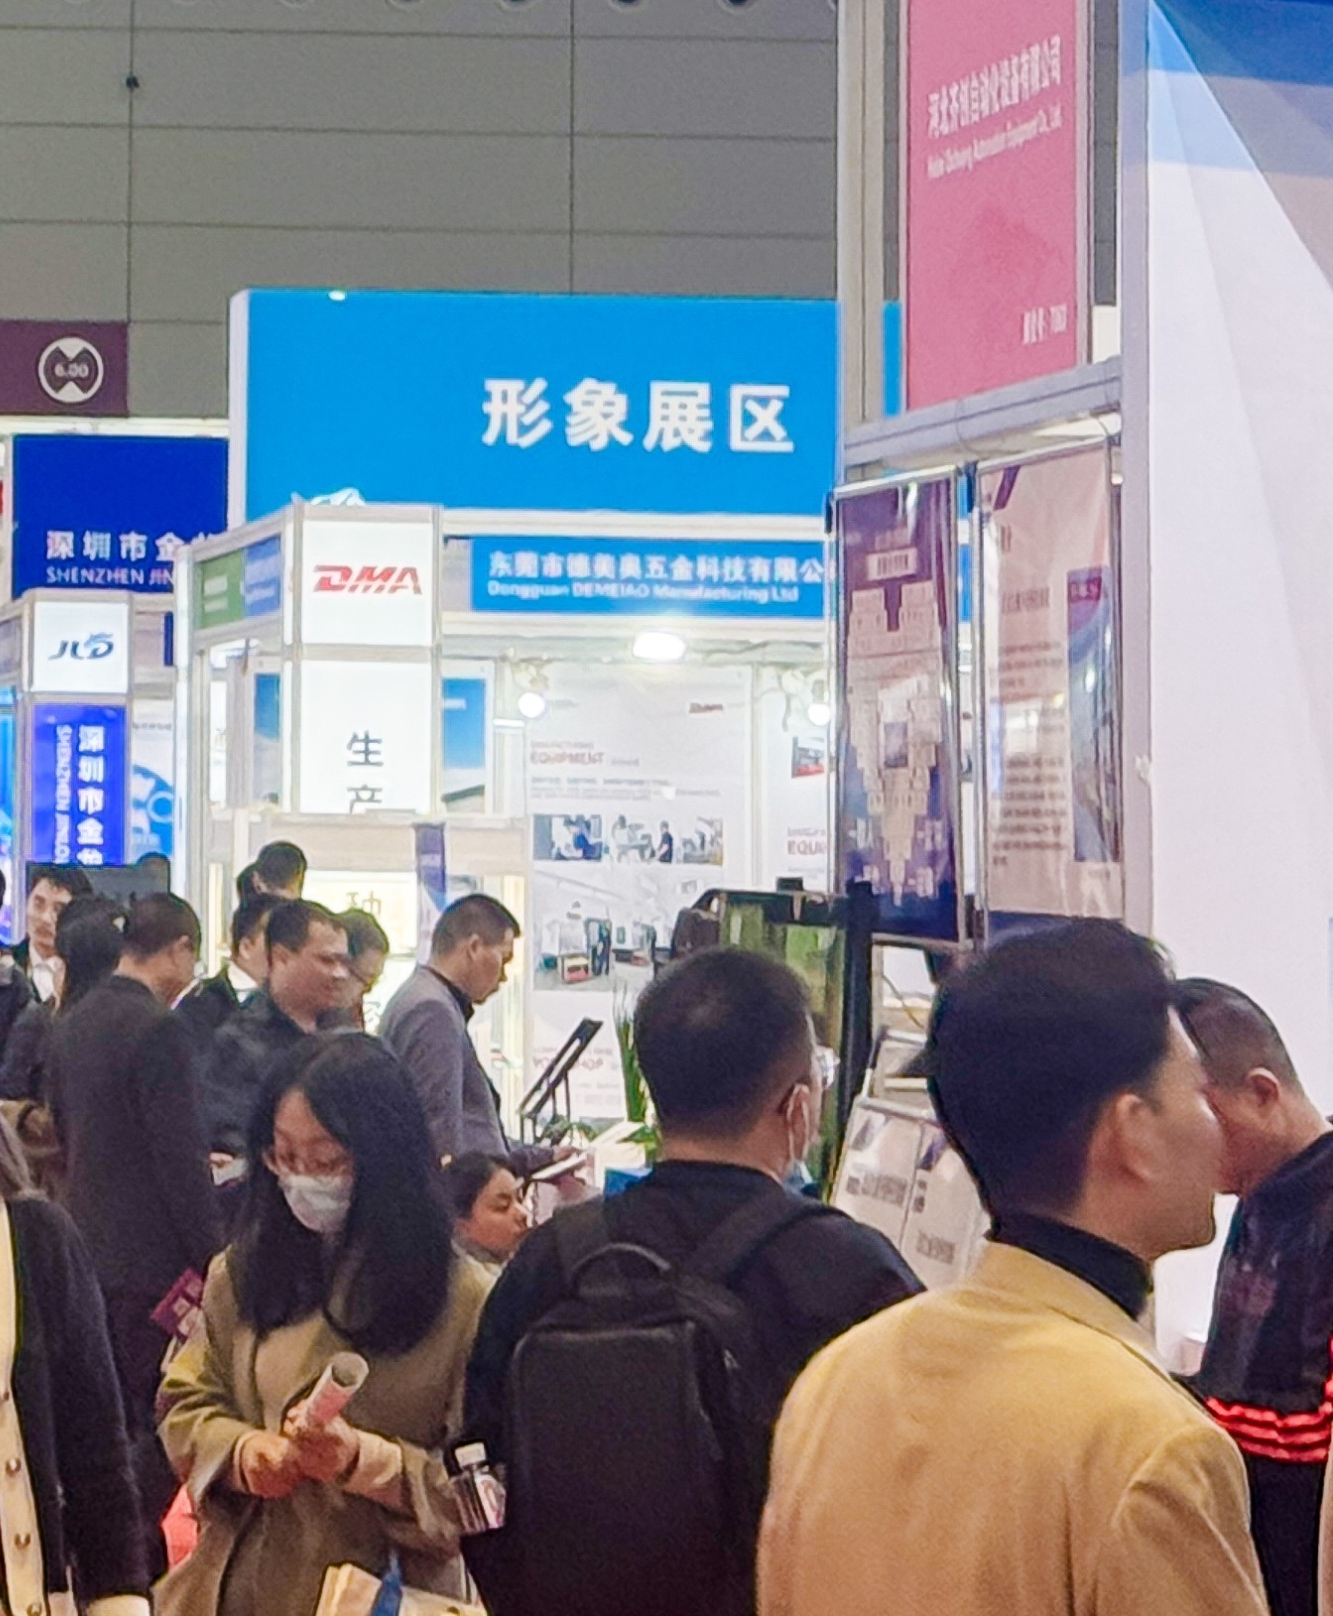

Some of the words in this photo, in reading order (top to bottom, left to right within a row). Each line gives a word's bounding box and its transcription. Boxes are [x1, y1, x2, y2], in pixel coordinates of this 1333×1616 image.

[482, 377, 794, 453] 形象展区
[46, 530, 185, 563] 深圳市金
[46, 566, 144, 585] SHENZHEN
[313, 565, 423, 595] DMA
[488, 550, 825, 583] 东莞市德美奥五金科技有限公
[346, 730, 384, 814] 生产
